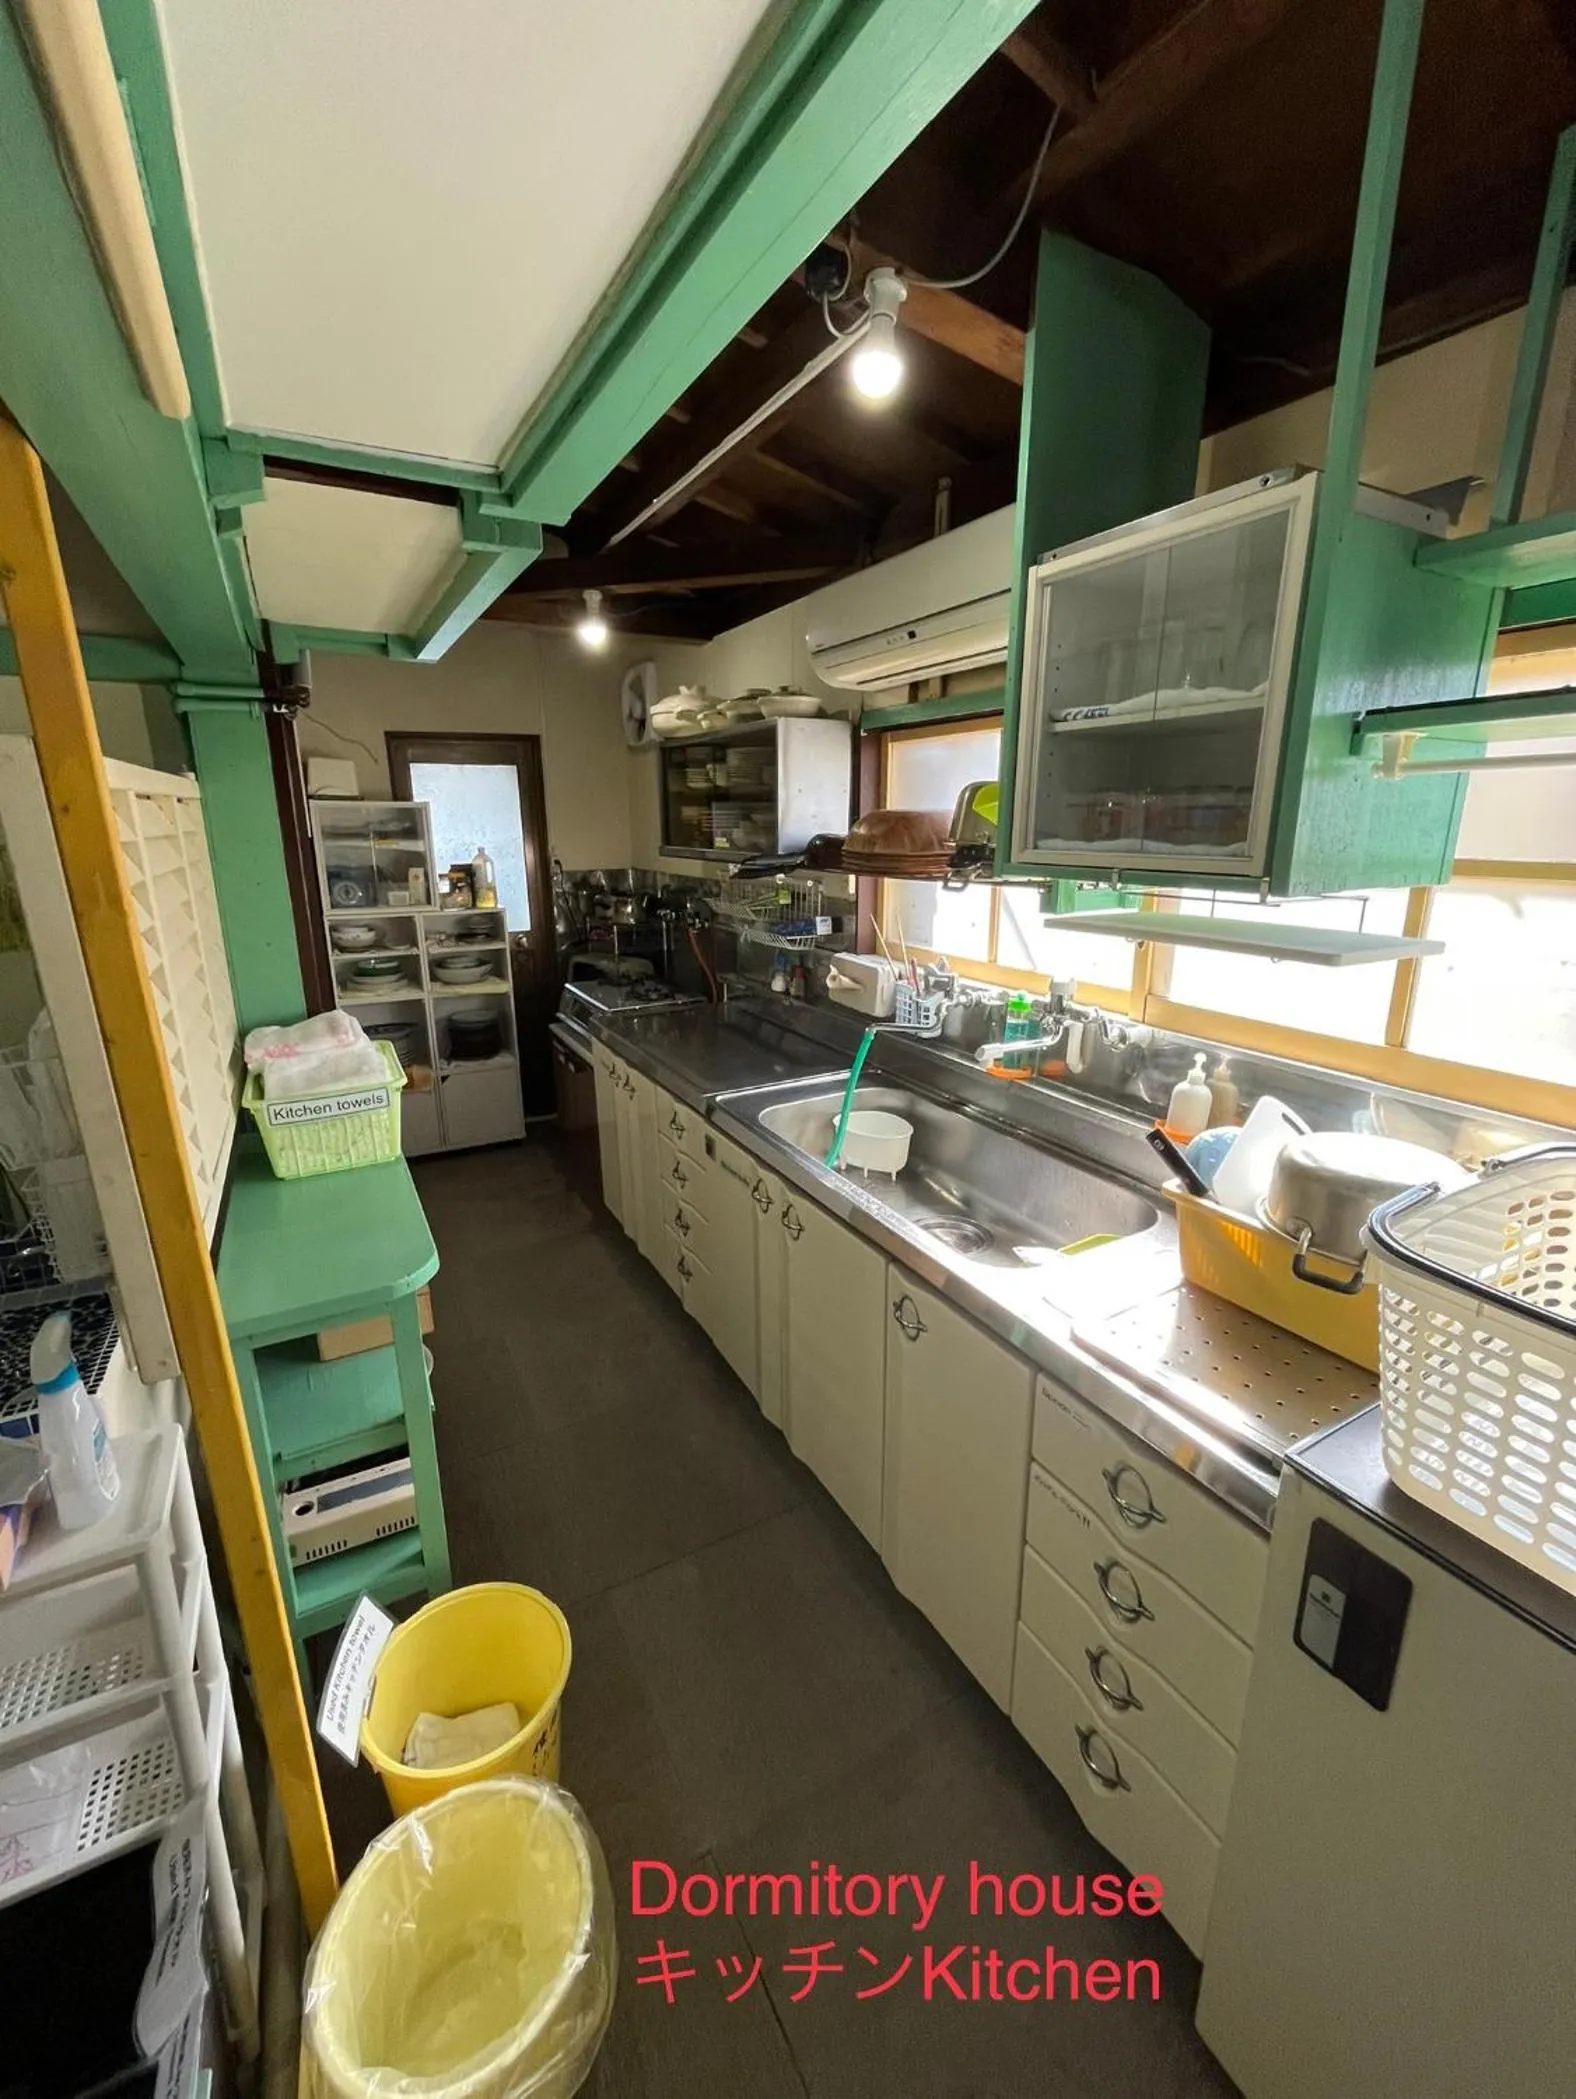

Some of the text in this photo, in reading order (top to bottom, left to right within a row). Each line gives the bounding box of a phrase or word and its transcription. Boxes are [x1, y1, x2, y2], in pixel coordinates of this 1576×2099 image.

[273, 1093, 384, 1121] Kitchen towels
[326, 1690, 339, 1721] Used
[348, 1615, 365, 1647] towel
